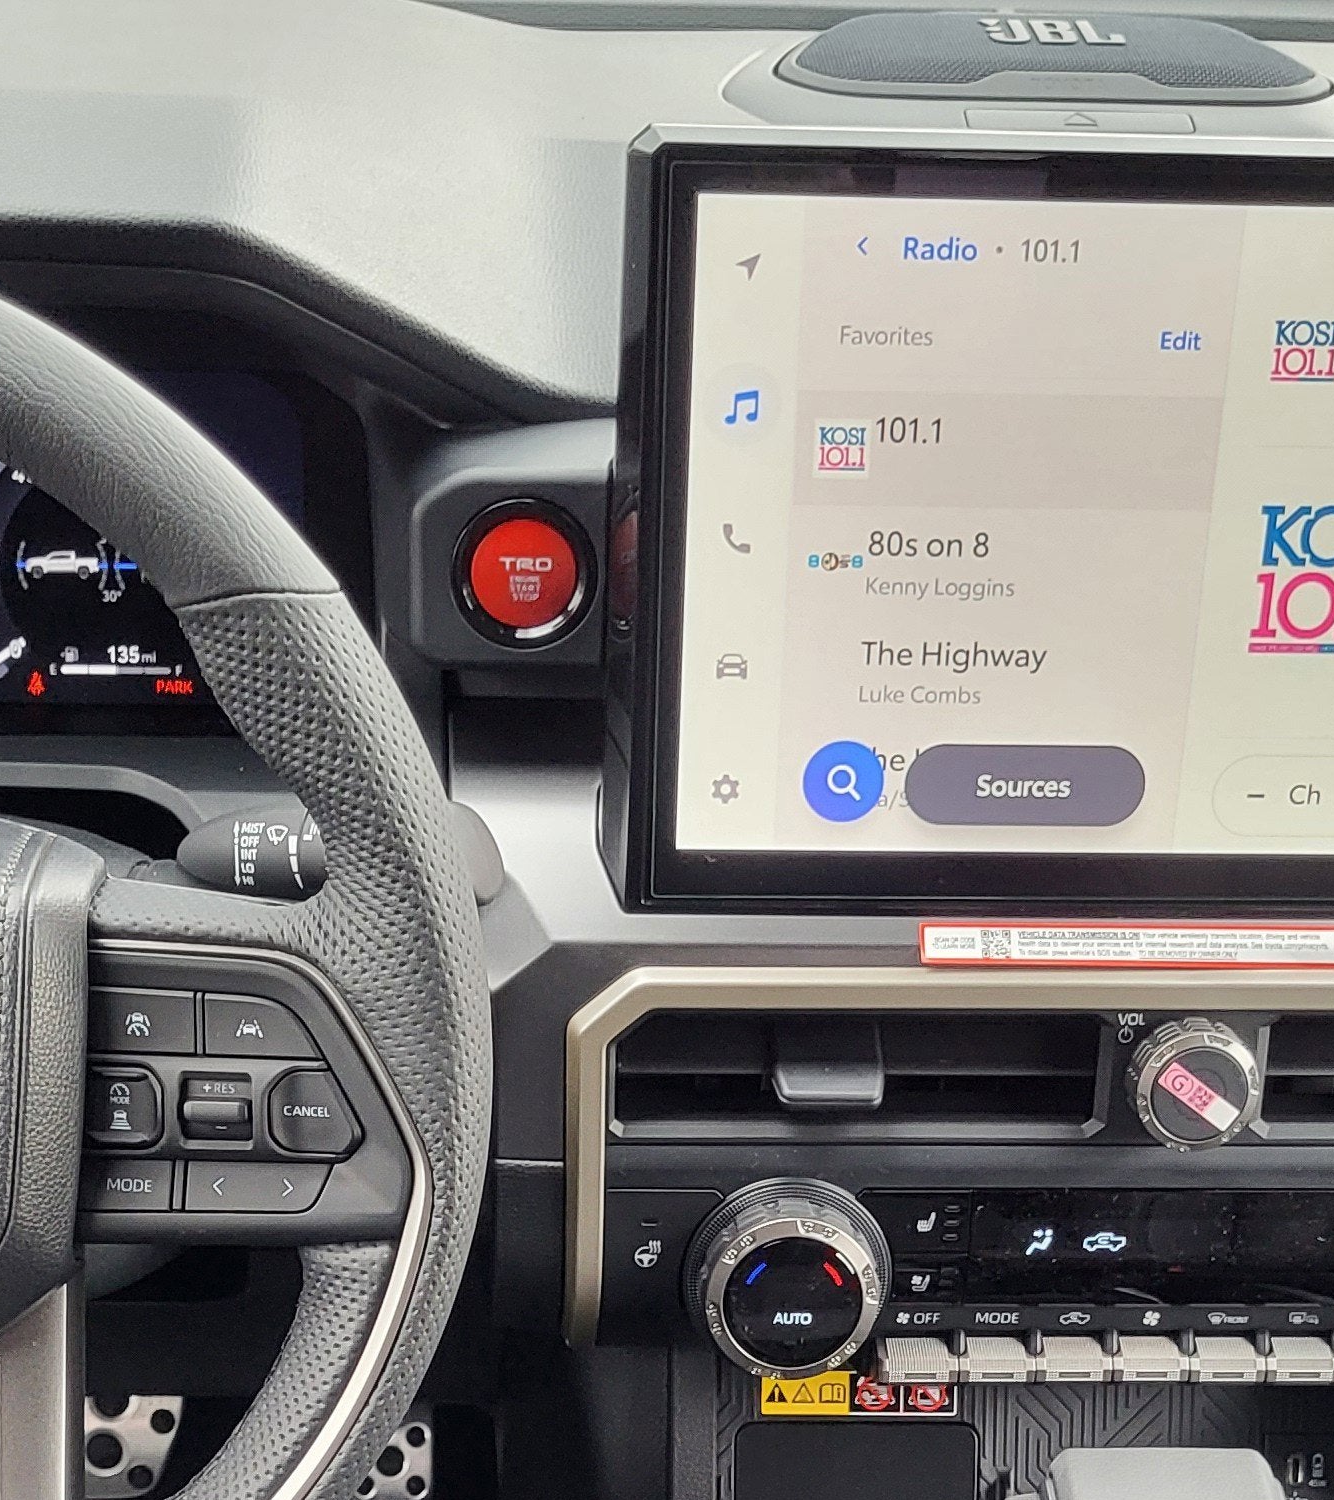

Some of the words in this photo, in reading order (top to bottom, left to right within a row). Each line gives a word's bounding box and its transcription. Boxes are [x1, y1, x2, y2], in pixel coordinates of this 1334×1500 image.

[978, 18, 1126, 46] JBL
[903, 237, 978, 262] Radio
[1020, 239, 1082, 264] 101.1
[839, 325, 934, 347] Favorites
[1159, 330, 1202, 352] Edit
[818, 426, 866, 446] KOSI
[875, 417, 943, 445] 101.1
[818, 447, 866, 469] 101.1
[868, 532, 918, 558] 80s
[927, 537, 964, 558] on
[972, 533, 991, 558] 8
[499, 557, 553, 571] TRD
[865, 578, 929, 600] Kenny
[934, 579, 1015, 601] Loggins
[862, 642, 913, 666] The
[921, 643, 1048, 674] Highway
[49, 662, 58, 675] E
[174, 664, 183, 676] F
[156, 679, 193, 695] PARK
[858, 686, 904, 704] Luke
[910, 686, 982, 705] Combs
[872, 746, 905, 771] he
[975, 773, 1071, 799] Sources
[1288, 783, 1321, 807] Ch
[241, 822, 266, 833] MIST
[241, 836, 259, 847] OFF
[241, 849, 257, 861] INT
[241, 862, 255, 874] LO
[1018, 931, 1048, 939] VEHICLE
[1049, 931, 1066, 939] DATA
[1118, 1013, 1145, 1026] VOL
[214, 1083, 235, 1094] RES
[283, 1105, 330, 1118] CANCEL
[107, 1178, 153, 1193] MODE
[772, 1312, 813, 1325] AUTO
[913, 1312, 941, 1325] OFF
[975, 1312, 1020, 1324] MODE
